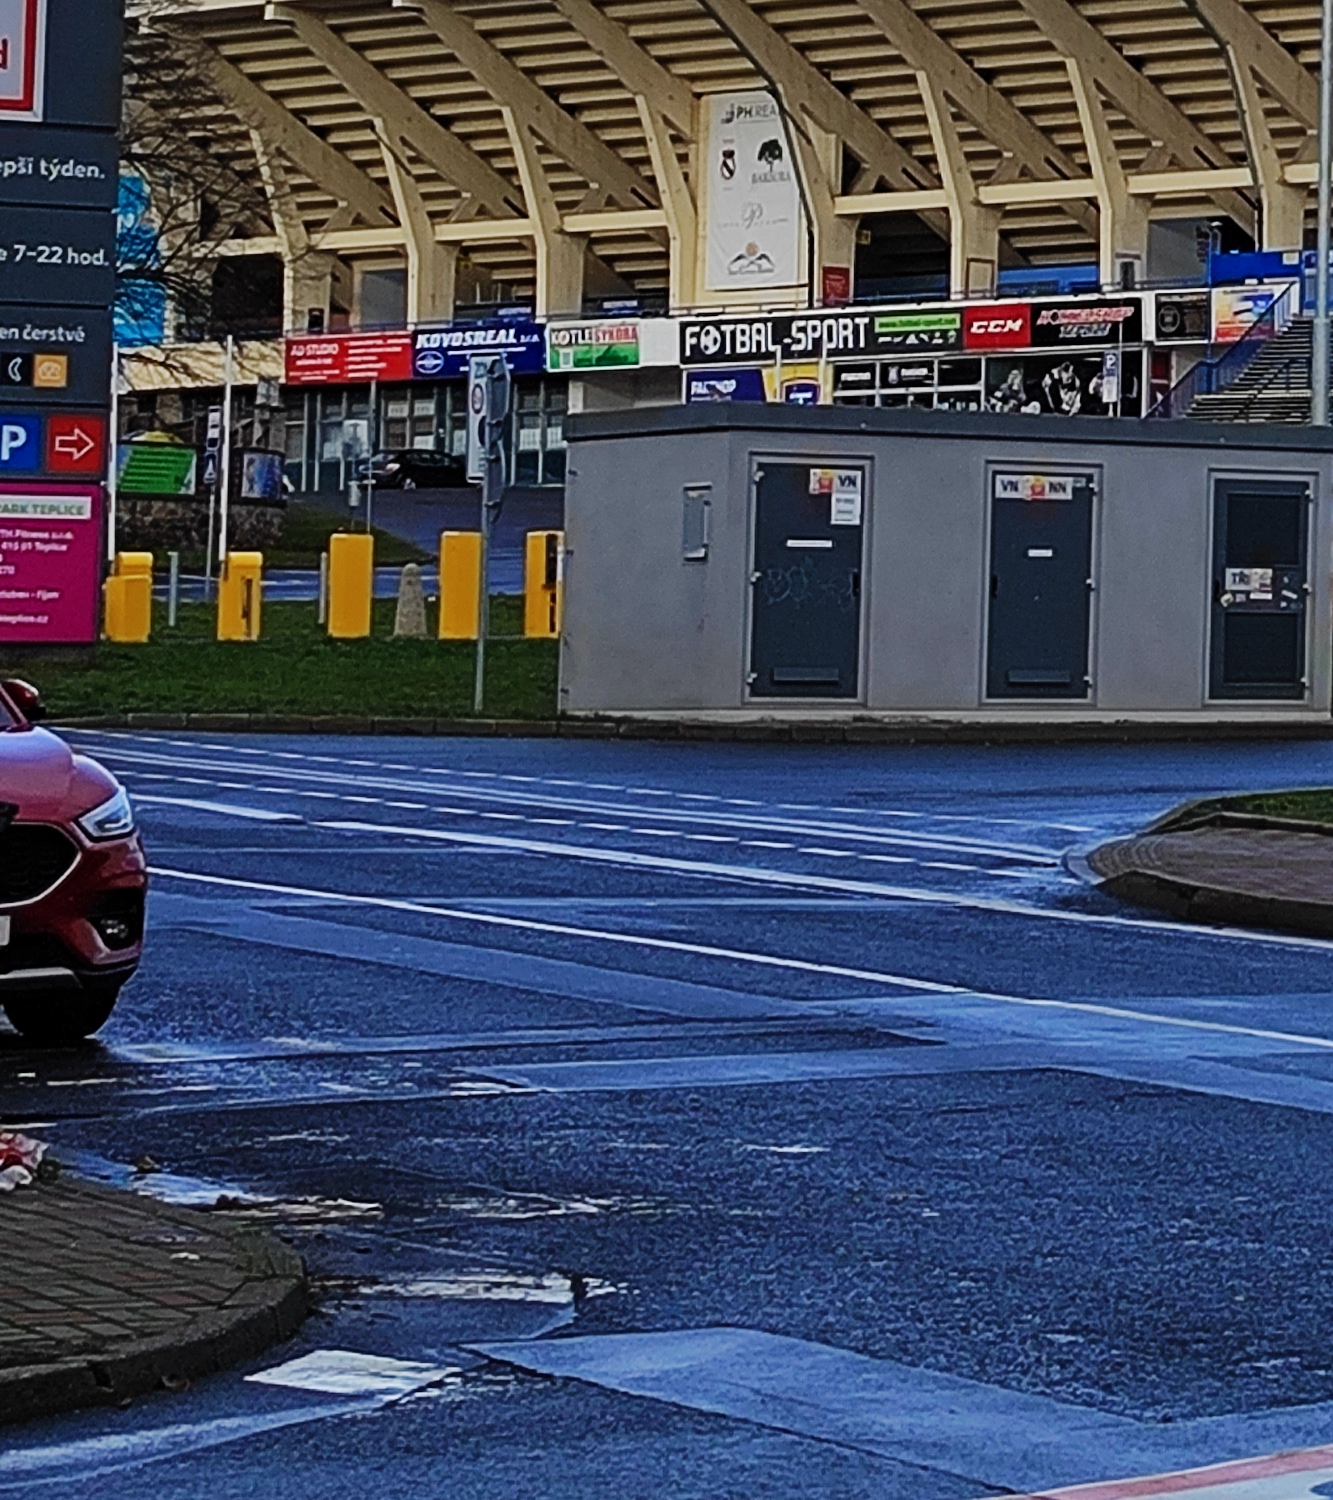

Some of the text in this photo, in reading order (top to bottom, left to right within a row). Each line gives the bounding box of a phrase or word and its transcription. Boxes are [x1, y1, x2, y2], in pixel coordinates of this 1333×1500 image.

[40, 157, 105, 181] týden.
[67, 247, 109, 266] hod.
[23, 324, 85, 343] čerstvé
[970, 318, 1023, 334] CCM
[416, 328, 517, 349] KOVOSREAL
[551, 329, 593, 346] KOTLE
[1, 425, 27, 461] P
[838, 474, 858, 488] VN
[1001, 479, 1020, 493] VN
[0, 503, 29, 513] ARK
